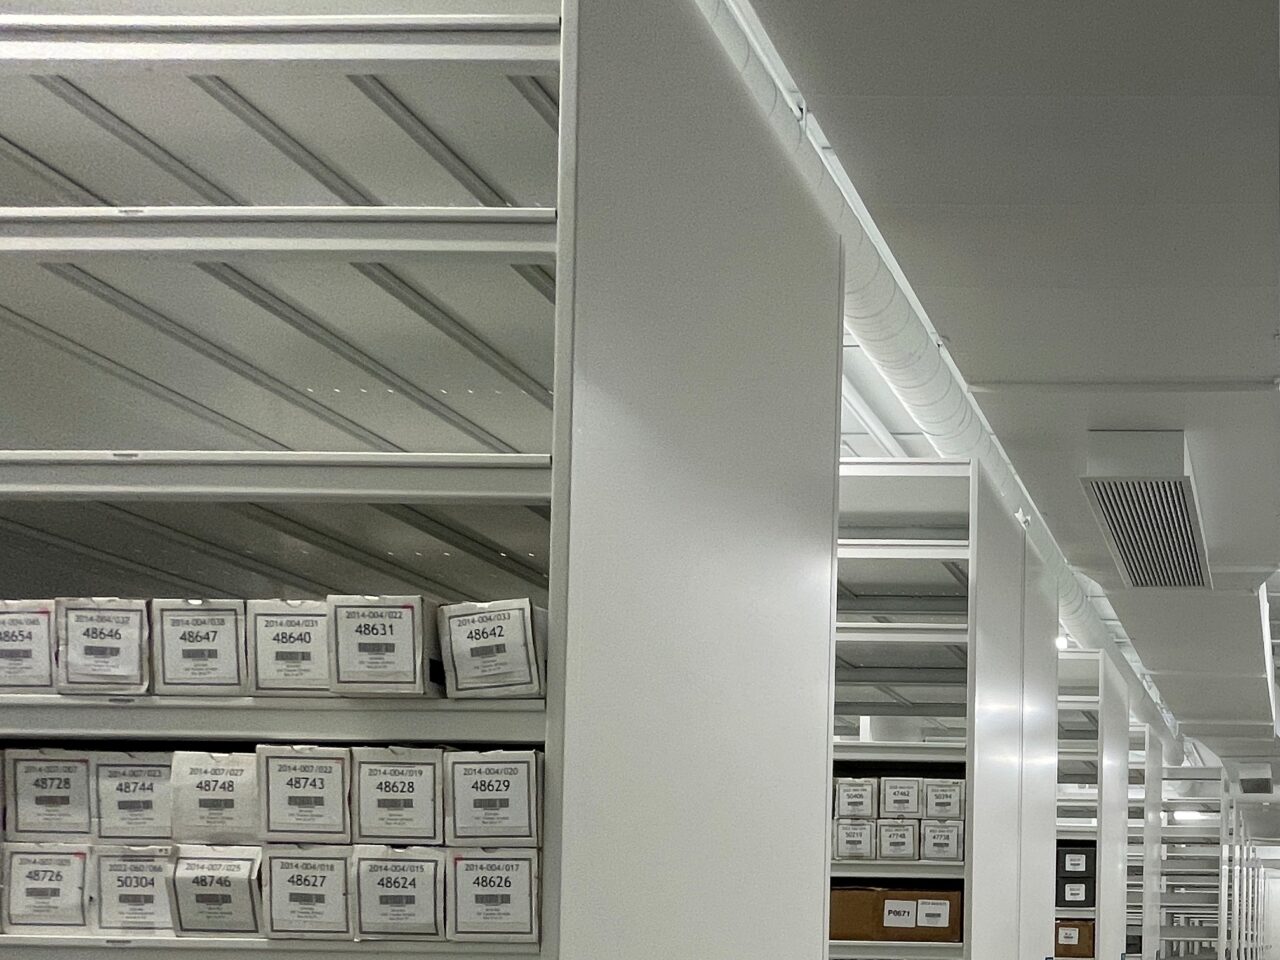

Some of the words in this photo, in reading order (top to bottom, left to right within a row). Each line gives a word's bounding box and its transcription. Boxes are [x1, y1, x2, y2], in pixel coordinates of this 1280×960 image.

[346, 610, 403, 620] 2014-004/022
[457, 612, 511, 627] 2014-004/033
[82, 627, 122, 640] 48646
[354, 623, 395, 636] 48631
[466, 625, 505, 641] 48642
[179, 630, 218, 643] 48647
[272, 631, 312, 644] 48640
[189, 767, 244, 777] 2014-007/027
[368, 768, 423, 777] 2014-004/019
[463, 767, 518, 776] 2014-004/020
[32, 777, 71, 790] 48728
[116, 782, 154, 794] 48744
[196, 780, 234, 792] 48748
[286, 777, 325, 790] 48743
[376, 781, 415, 793] 48628
[471, 780, 510, 792] 48629
[368, 864, 424, 873] 2014-004/015
[465, 863, 519, 872] 2014-004/017
[25, 869, 63, 882] 48726
[116, 876, 155, 888] 50304
[191, 875, 232, 888] 48746
[287, 874, 326, 887] 48627
[473, 875, 512, 888] 48626
[377, 876, 416, 889] 48624
[887, 909, 910, 917] P0671
